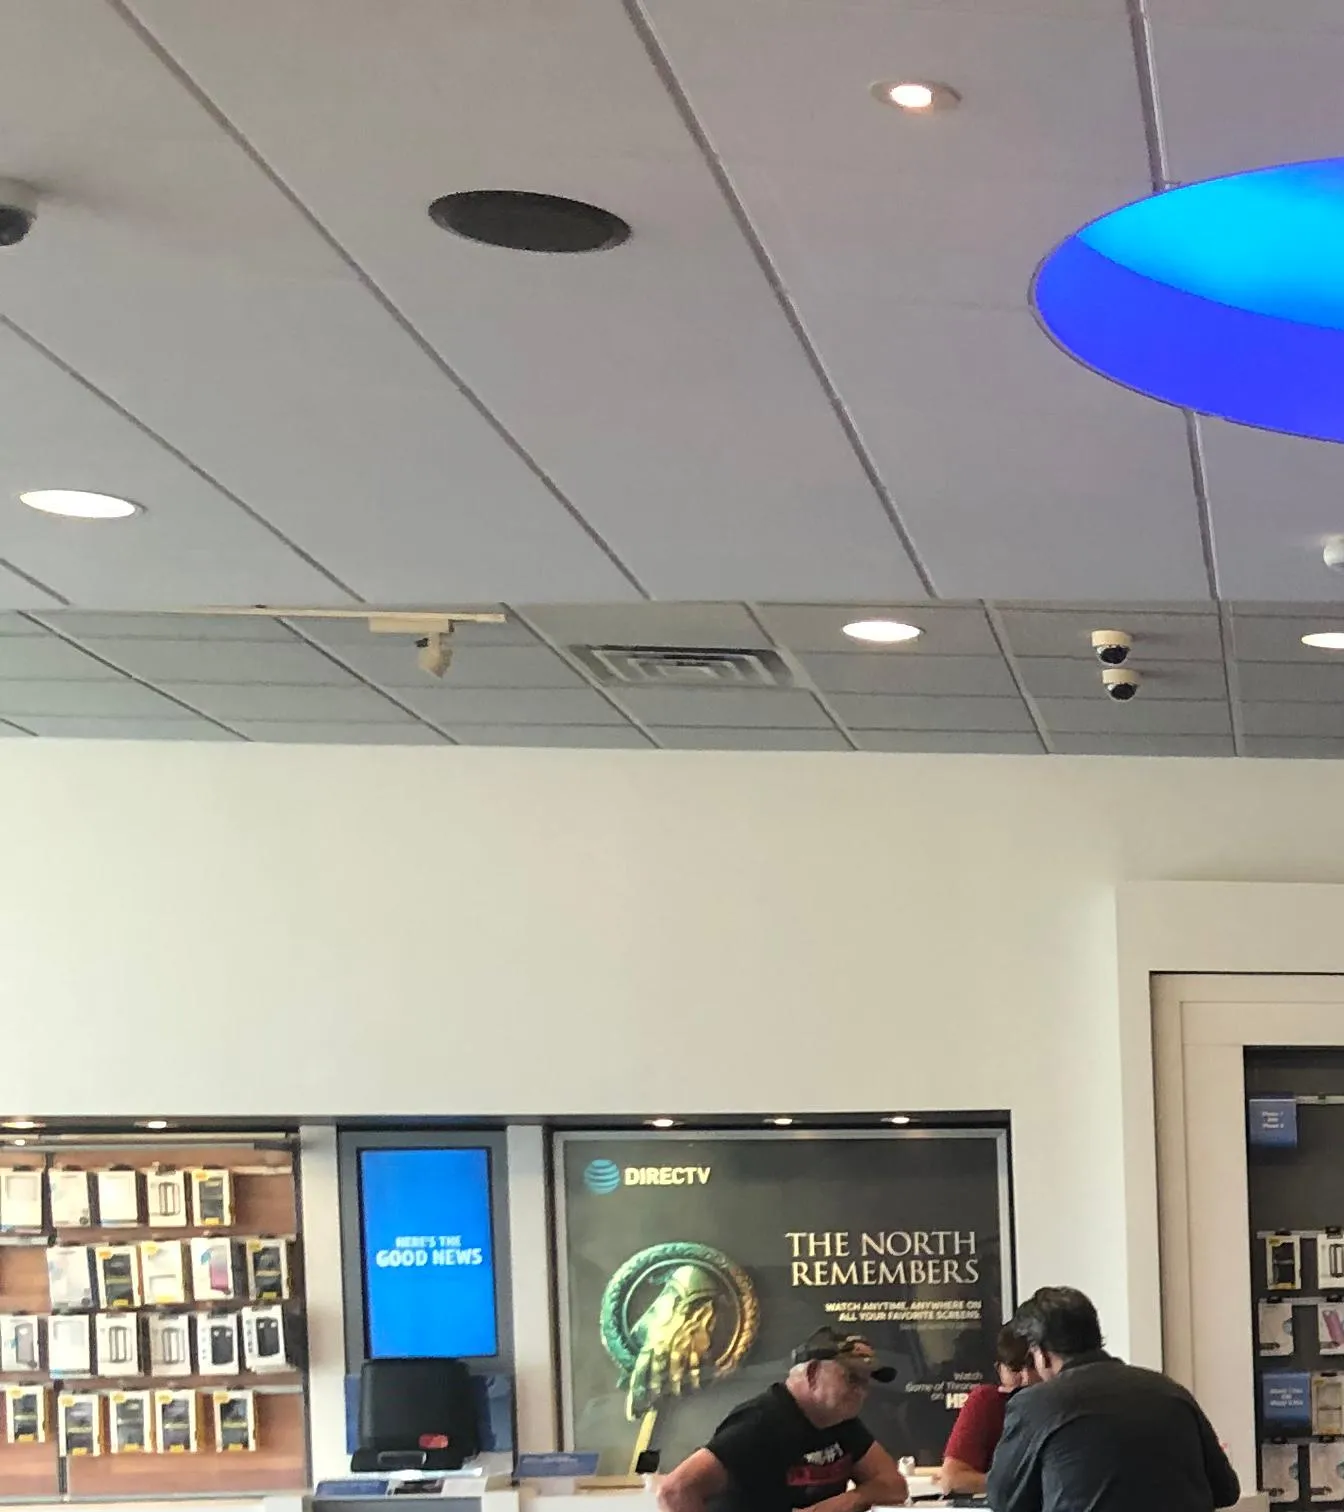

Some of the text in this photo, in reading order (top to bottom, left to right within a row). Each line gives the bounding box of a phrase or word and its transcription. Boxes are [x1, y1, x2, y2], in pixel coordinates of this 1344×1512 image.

[624, 1167, 711, 1186] DIRECTV
[439, 1235, 462, 1248] THE
[785, 1231, 976, 1257] THE NORTH
[376, 1248, 483, 1267] GOOD NEWS
[791, 1259, 979, 1286] REMEMBERS
[825, 1302, 861, 1312] WATCH
[910, 1300, 964, 1310] ANYWHERE
[966, 1300, 982, 1309] ON
[838, 1312, 857, 1322] ALL
[859, 1312, 886, 1321] YOUR
[888, 1311, 934, 1321] FAVORITE
[905, 1382, 933, 1392] Game
[933, 1381, 945, 1392] of
[930, 1393, 944, 1401] on
